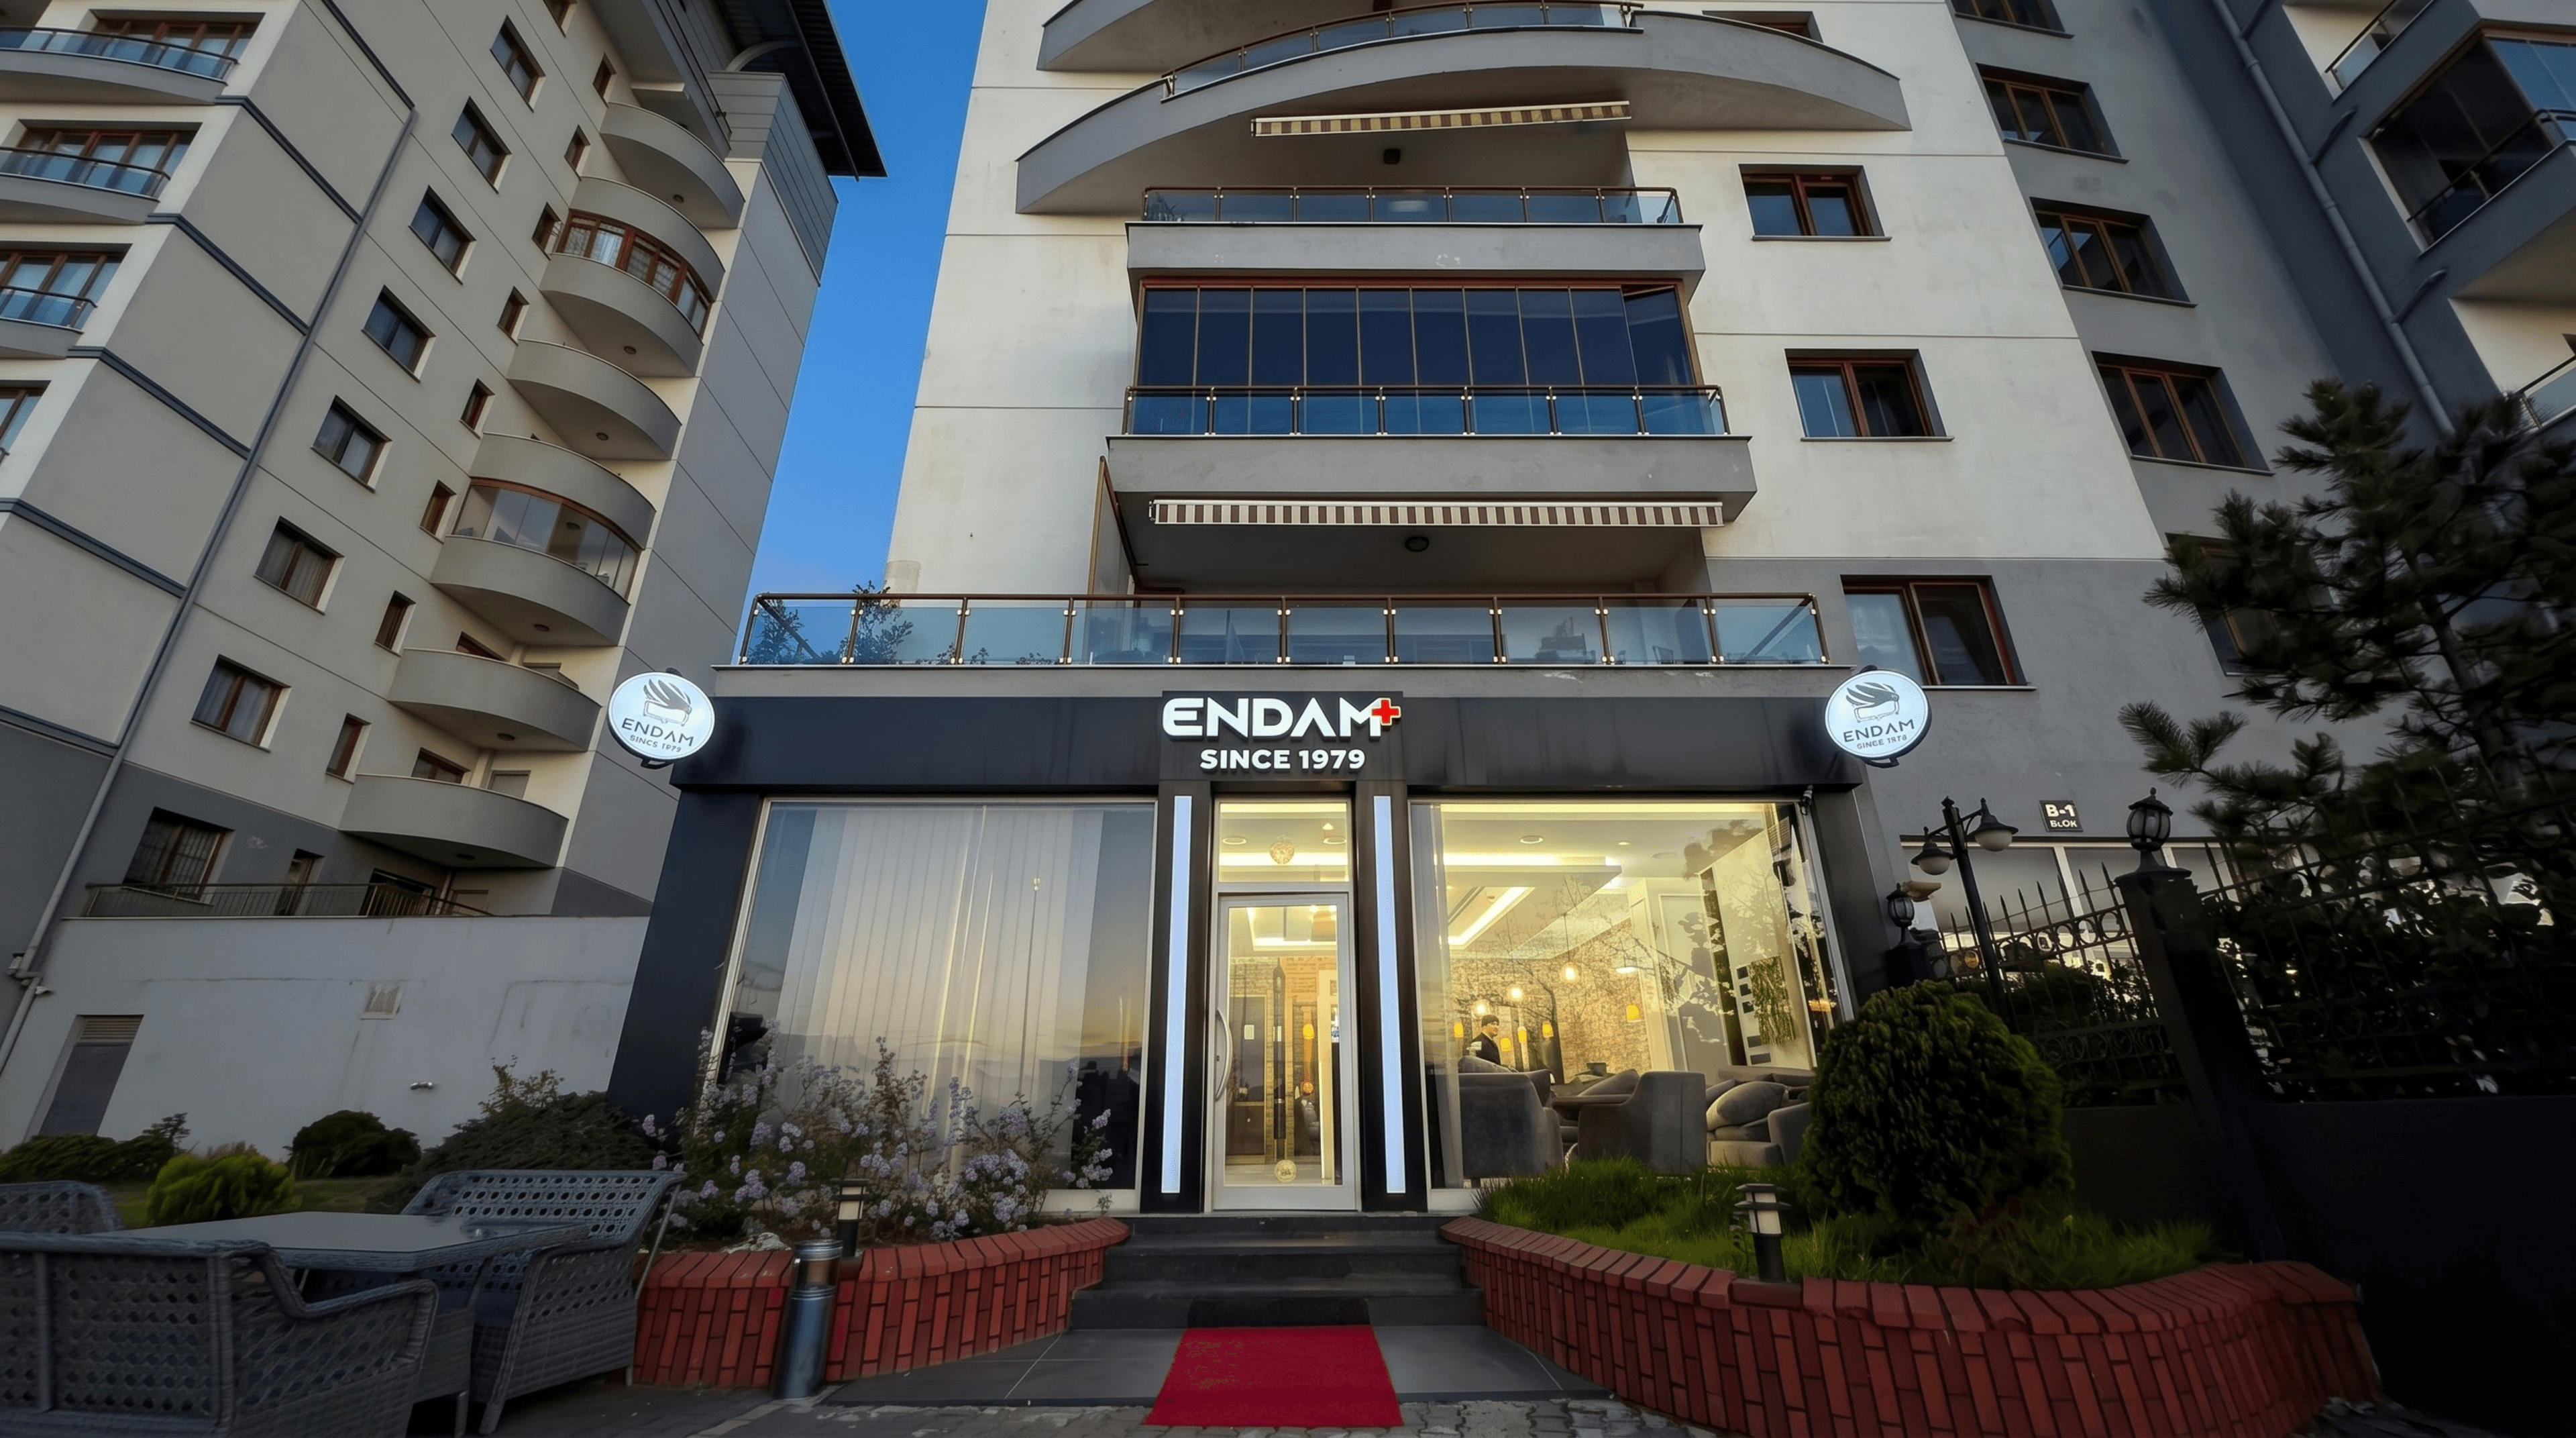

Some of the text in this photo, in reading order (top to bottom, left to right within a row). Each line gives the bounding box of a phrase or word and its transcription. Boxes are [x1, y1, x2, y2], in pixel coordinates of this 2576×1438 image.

[1162, 697, 1382, 738] ENDAM
[621, 717, 694, 747] ENDAM
[1843, 719, 1915, 742] ENDAM
[1199, 748, 1366, 770] SINCE 1979
[2045, 804, 2076, 817] B-1
[2049, 819, 2078, 827] BLOK
